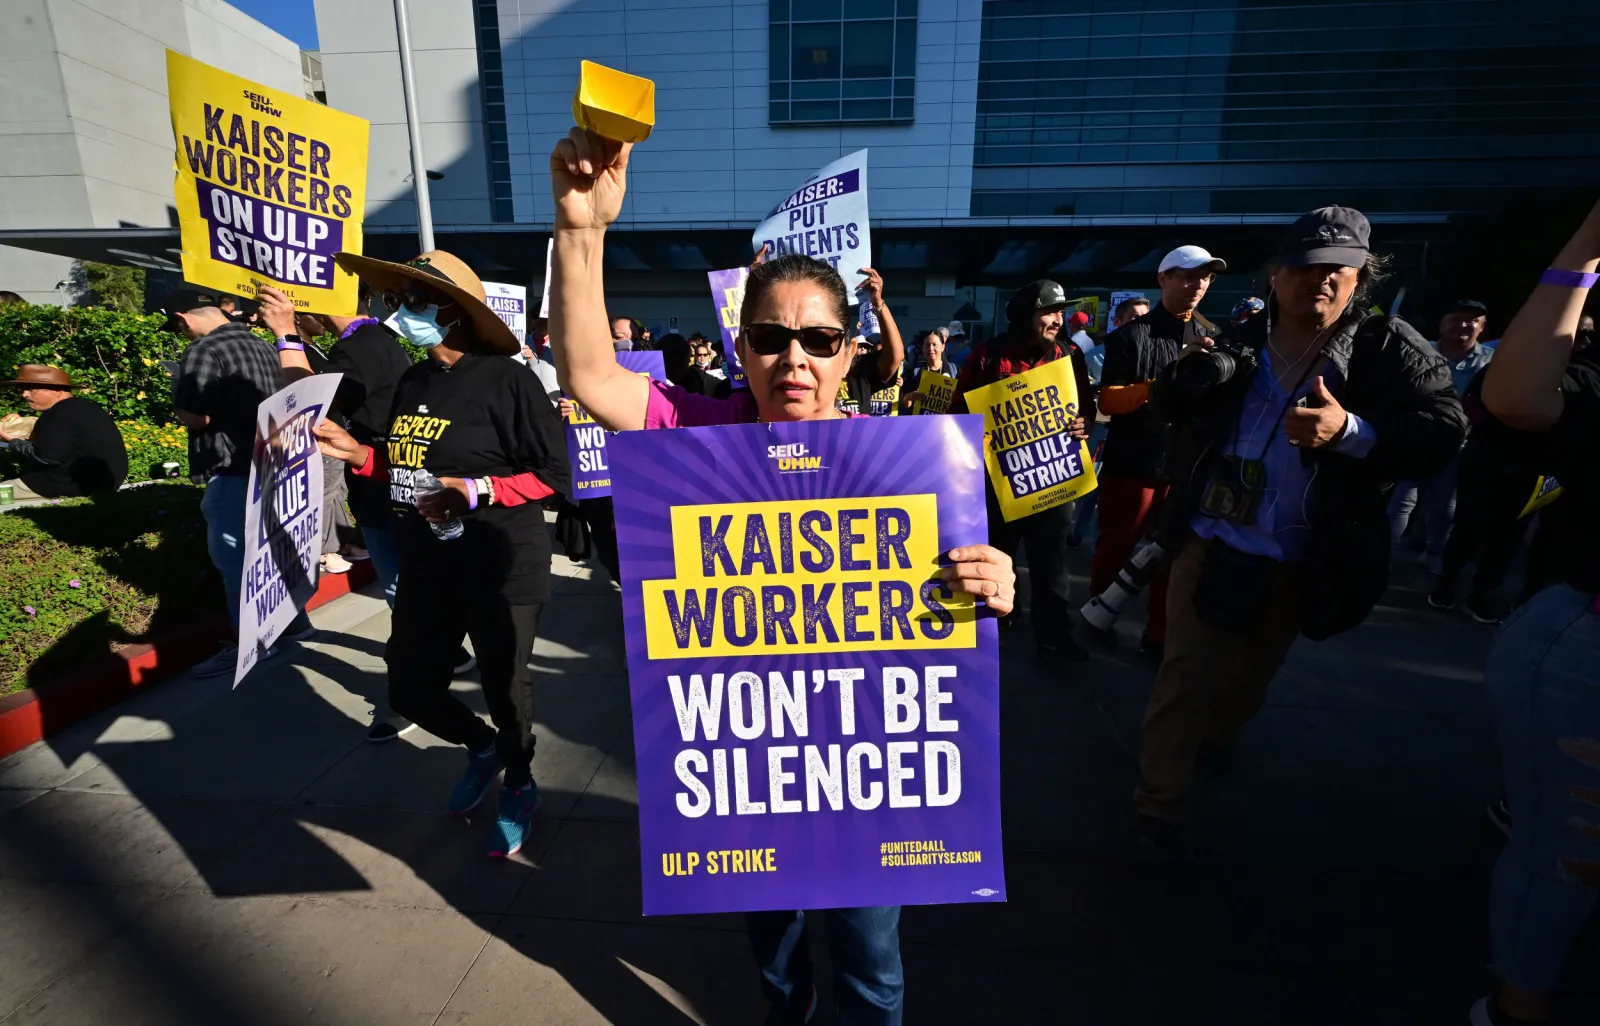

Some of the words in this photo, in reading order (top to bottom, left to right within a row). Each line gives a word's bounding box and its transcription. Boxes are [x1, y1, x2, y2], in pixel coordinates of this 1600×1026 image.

[243, 89, 273, 106] SEIU-
[250, 101, 282, 118] UHW
[203, 102, 331, 179] KAISER
[182, 134, 352, 219] WORKERS
[777, 177, 844, 213] KAISER:
[210, 188, 254, 235] ON
[263, 204, 329, 251] ULP
[789, 201, 828, 232] PUT
[216, 226, 327, 286] STRIKE
[762, 222, 860, 260] PATIENTS
[486, 297, 521, 312] KAISER:
[920, 395, 951, 414] WORK
[929, 383, 953, 402] KAIS
[990, 384, 1062, 427] KAISER
[1011, 382, 1028, 393] UHW
[984, 402, 1079, 452] WORKERS
[767, 444, 809, 458] SEIU-
[778, 456, 822, 471] UHW
[1005, 442, 1035, 473] ON
[1035, 432, 1072, 467] ULP
[577, 481, 589, 490] ULP
[1012, 453, 1081, 496] STRIKE
[699, 507, 912, 577] KAISER
[663, 577, 955, 649] WORKERS
[667, 667, 865, 742] WON'T
[883, 665, 959, 734] BE
[674, 740, 962, 818] SILENCED
[662, 852, 700, 877] ULP
[706, 848, 777, 874] STRIKE
[880, 840, 946, 854] #UNITED4ALL
[880, 851, 982, 867] #SOLIDARITYSEASON
